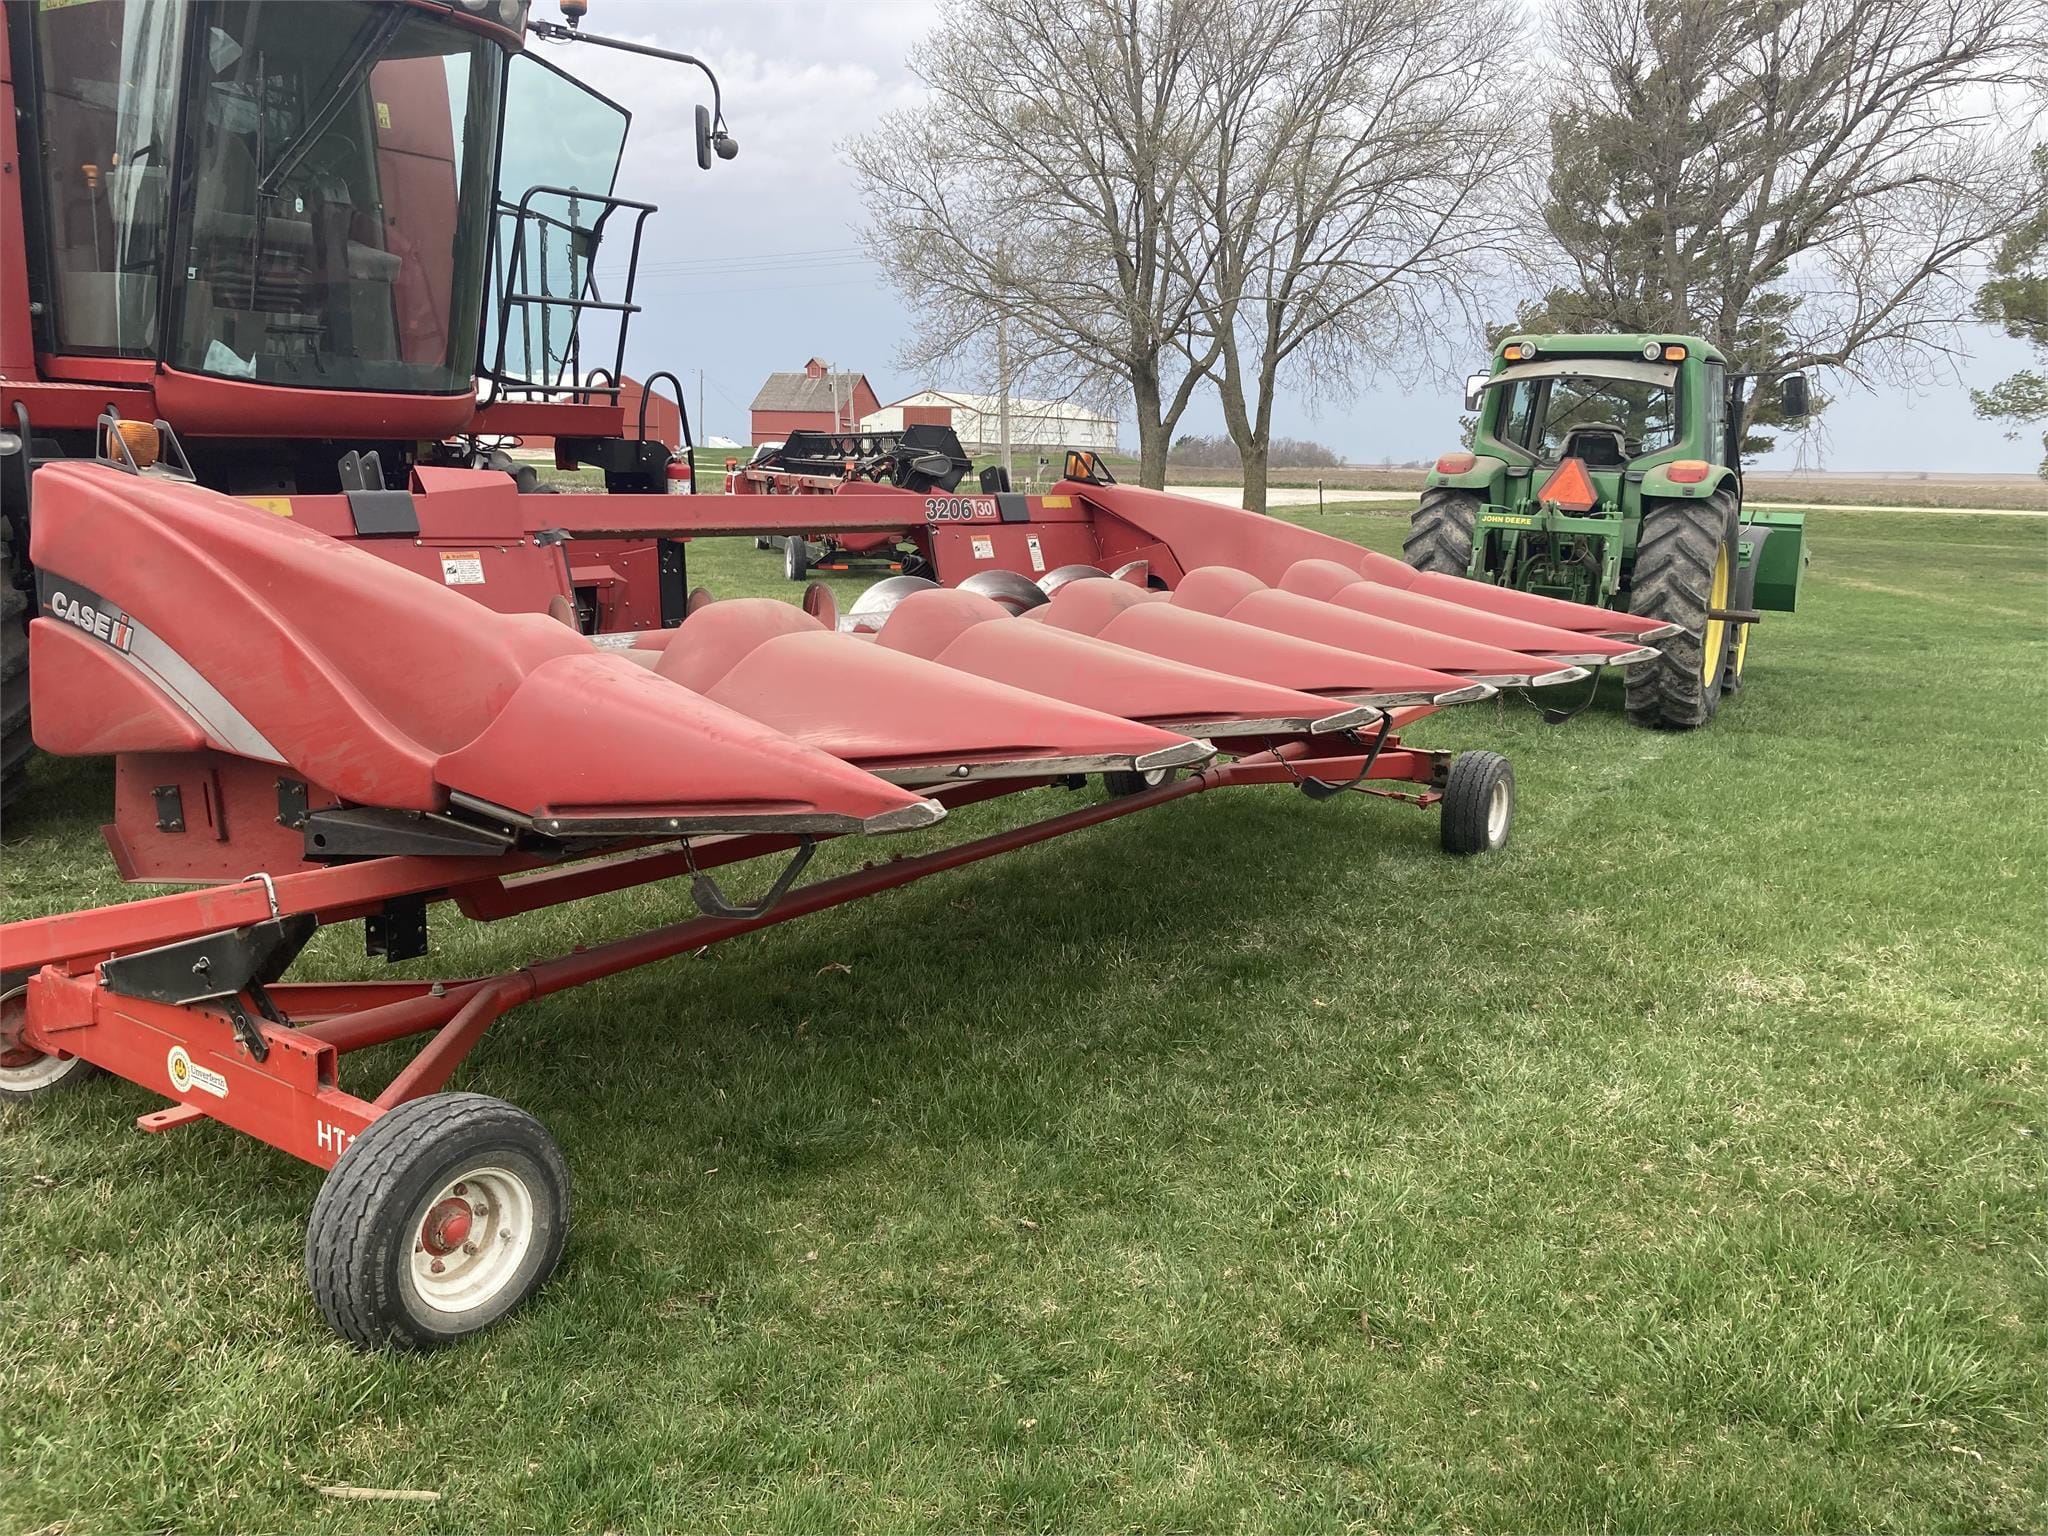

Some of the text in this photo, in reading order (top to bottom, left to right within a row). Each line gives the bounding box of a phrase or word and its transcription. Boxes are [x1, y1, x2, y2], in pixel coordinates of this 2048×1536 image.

[925, 497, 992, 521] 3206 30
[1481, 515, 1532, 525] JOHN DEERE
[52, 591, 112, 641] CASE
[317, 1119, 356, 1156] HT
